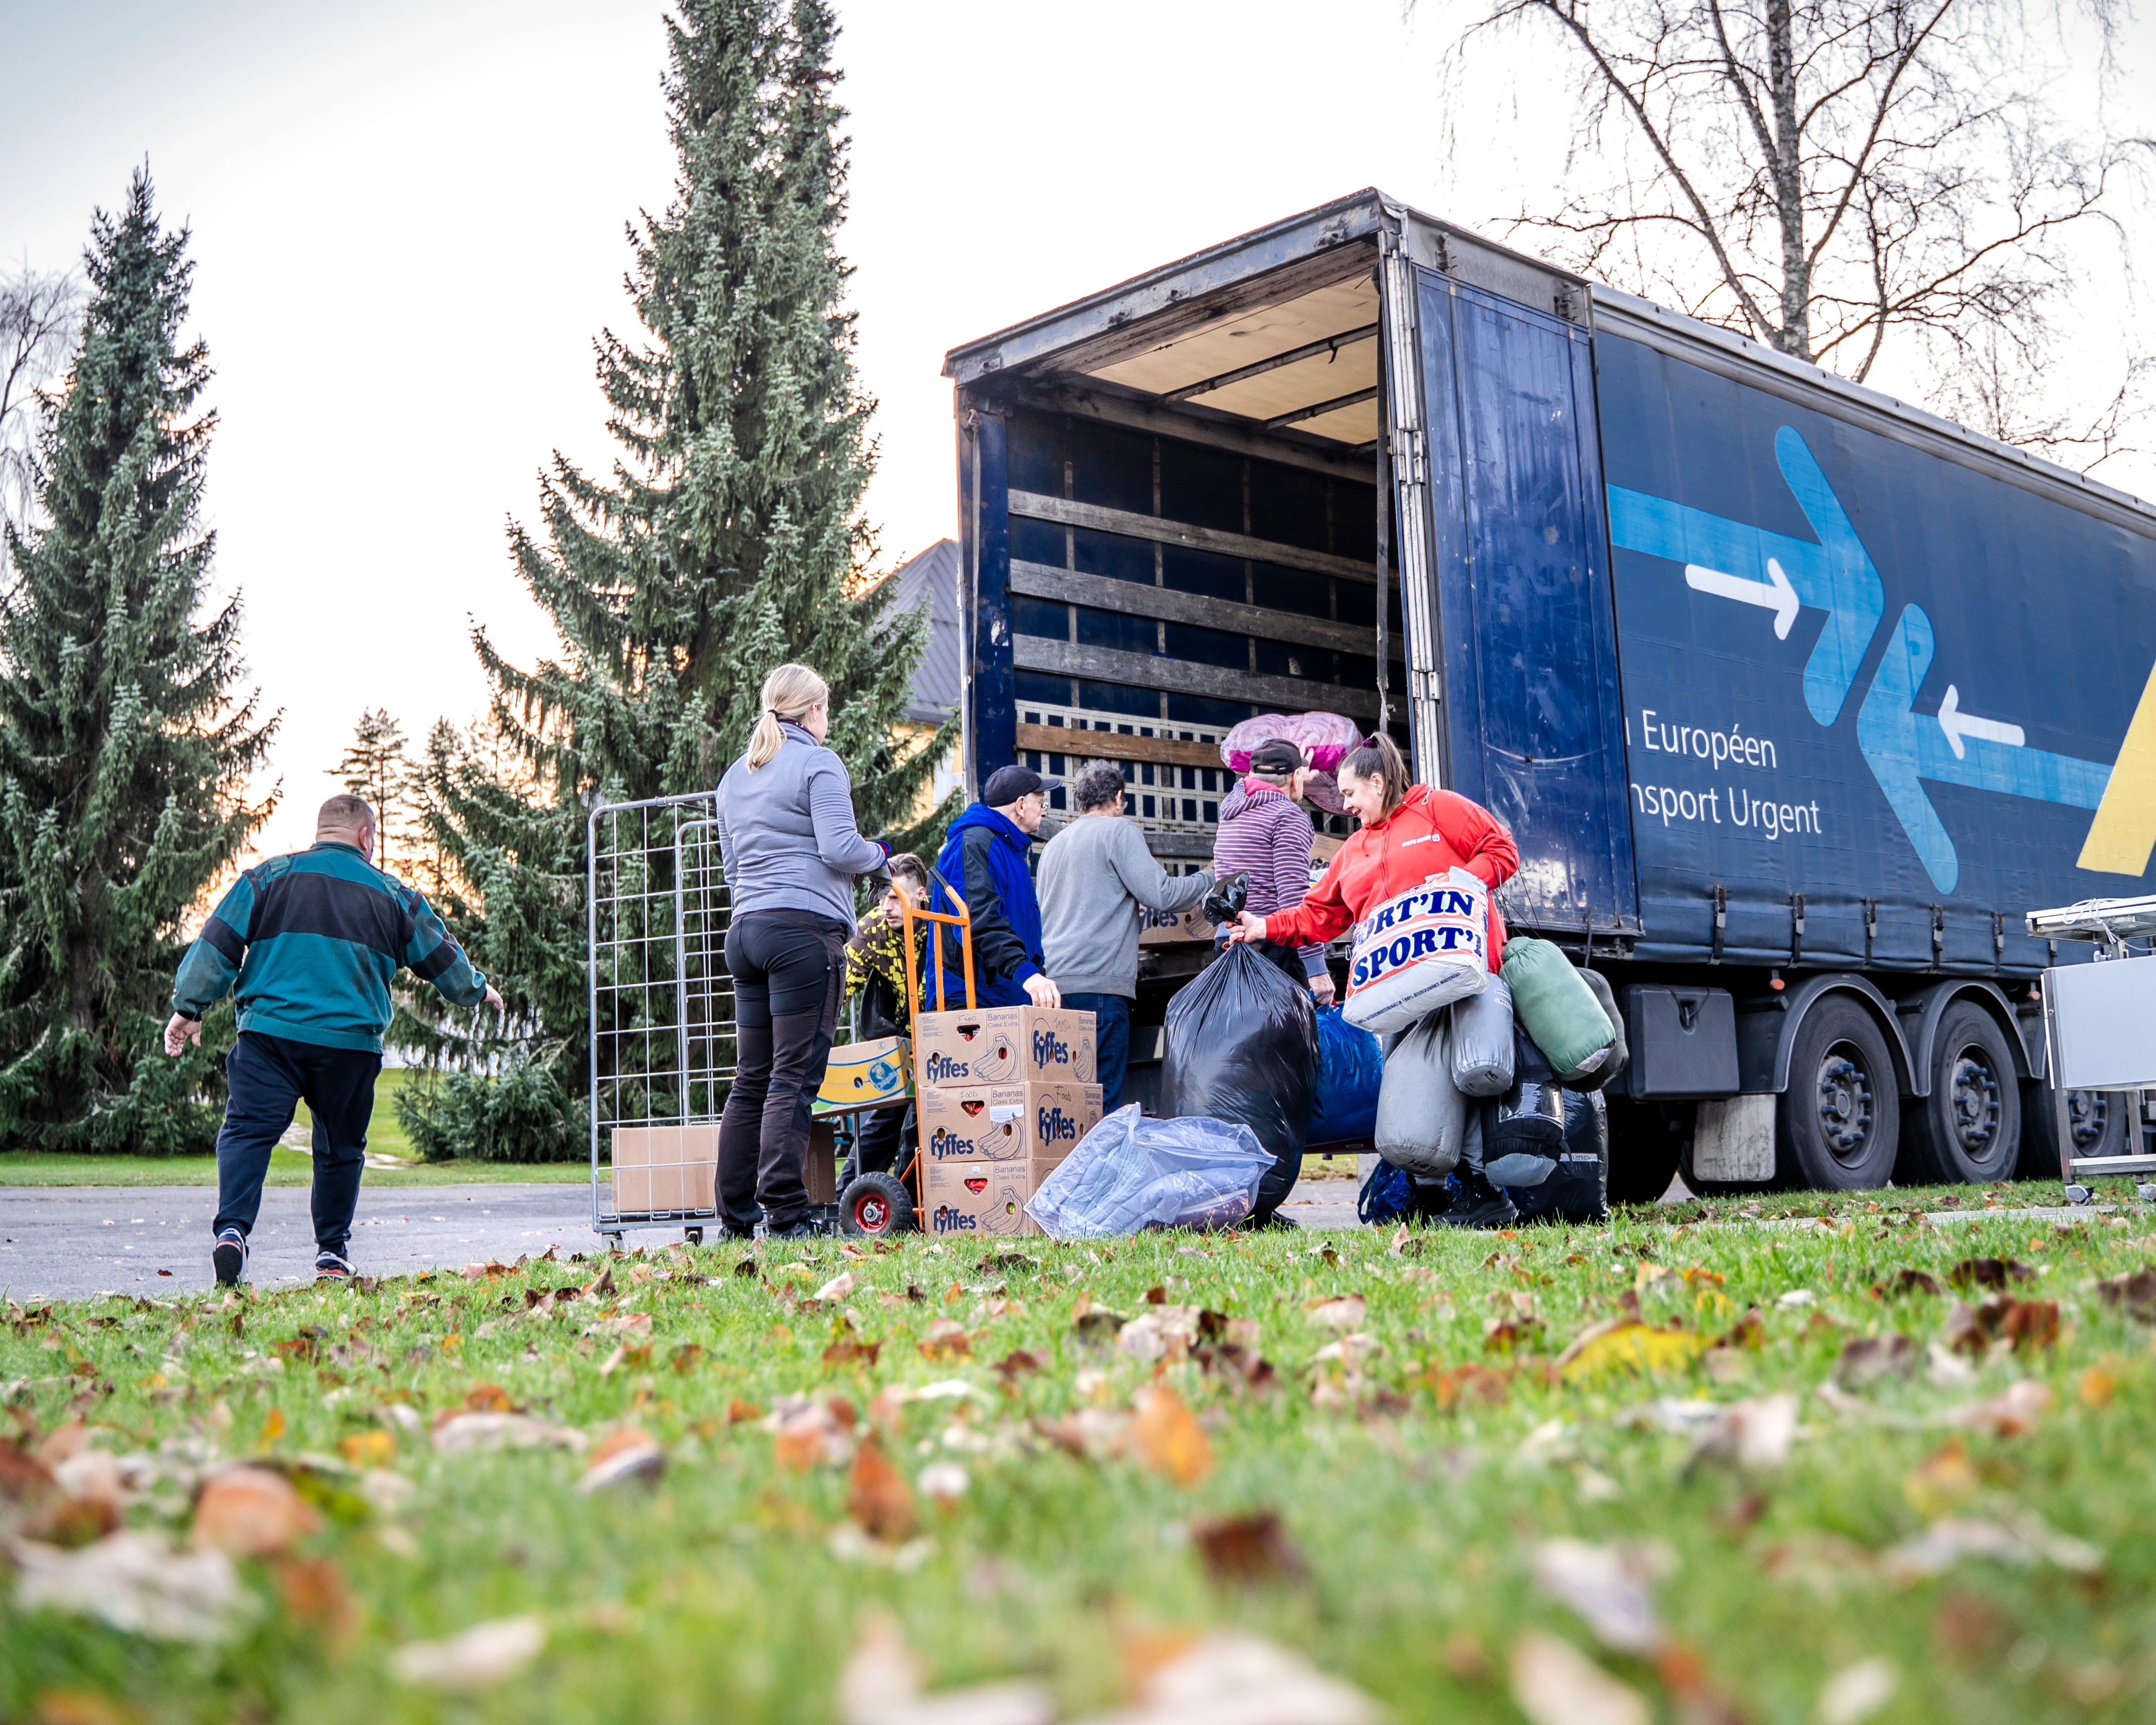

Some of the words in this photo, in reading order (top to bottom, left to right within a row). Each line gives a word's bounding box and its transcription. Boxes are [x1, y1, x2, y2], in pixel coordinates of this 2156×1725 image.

[1643, 710, 1777, 770] Européen
[1729, 787, 1821, 840] Urgent
[1440, 972, 1461, 985] MATERIAL
[988, 1013, 1018, 1021] Bananas
[1033, 1030, 1068, 1069] fyffes
[875, 1070, 898, 1091] Chiquita
[927, 1057, 969, 1084] fyffes
[1039, 1107, 1075, 1146] fyffes
[931, 1134, 974, 1160] fyffes
[995, 1165, 1025, 1173] Bananas
[934, 1209, 977, 1235] fyffes
